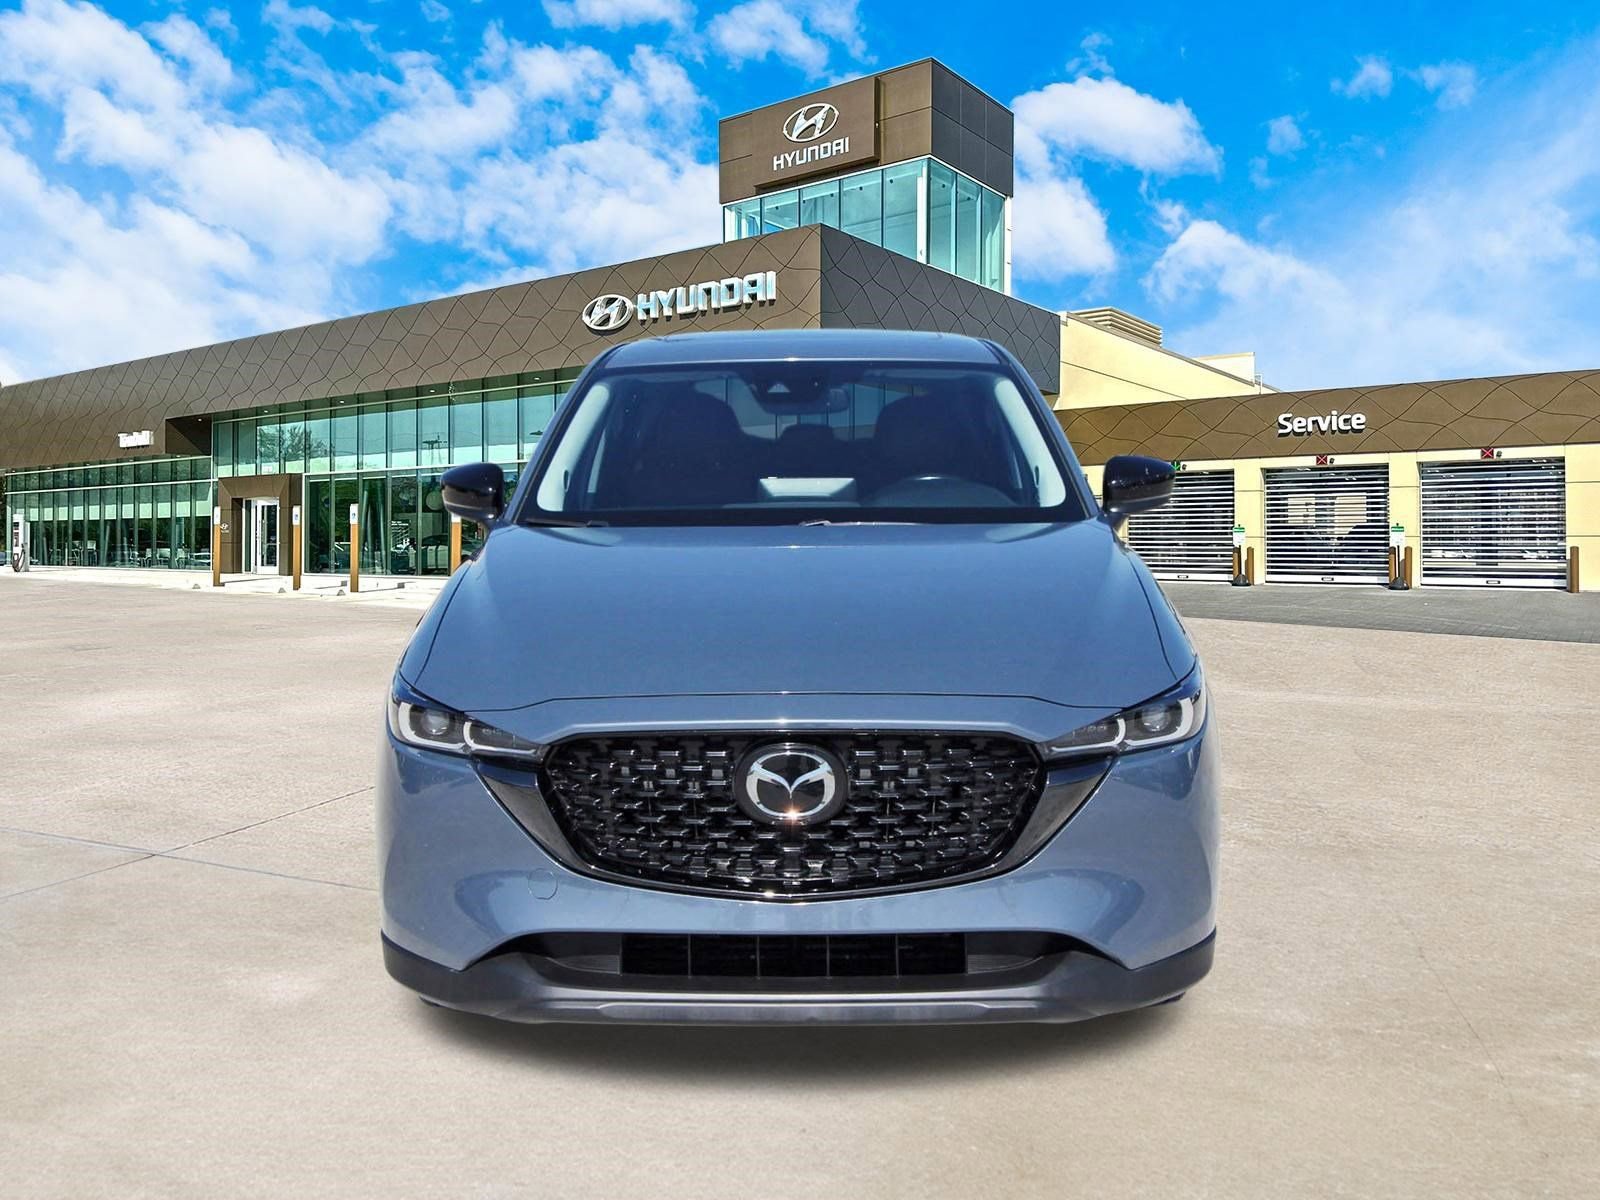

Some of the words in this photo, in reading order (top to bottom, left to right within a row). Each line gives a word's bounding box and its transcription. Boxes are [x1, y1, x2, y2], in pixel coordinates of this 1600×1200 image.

[773, 136, 850, 171] HYUNDAI
[637, 271, 777, 321] HYUNDAI
[1277, 410, 1366, 434] Service
